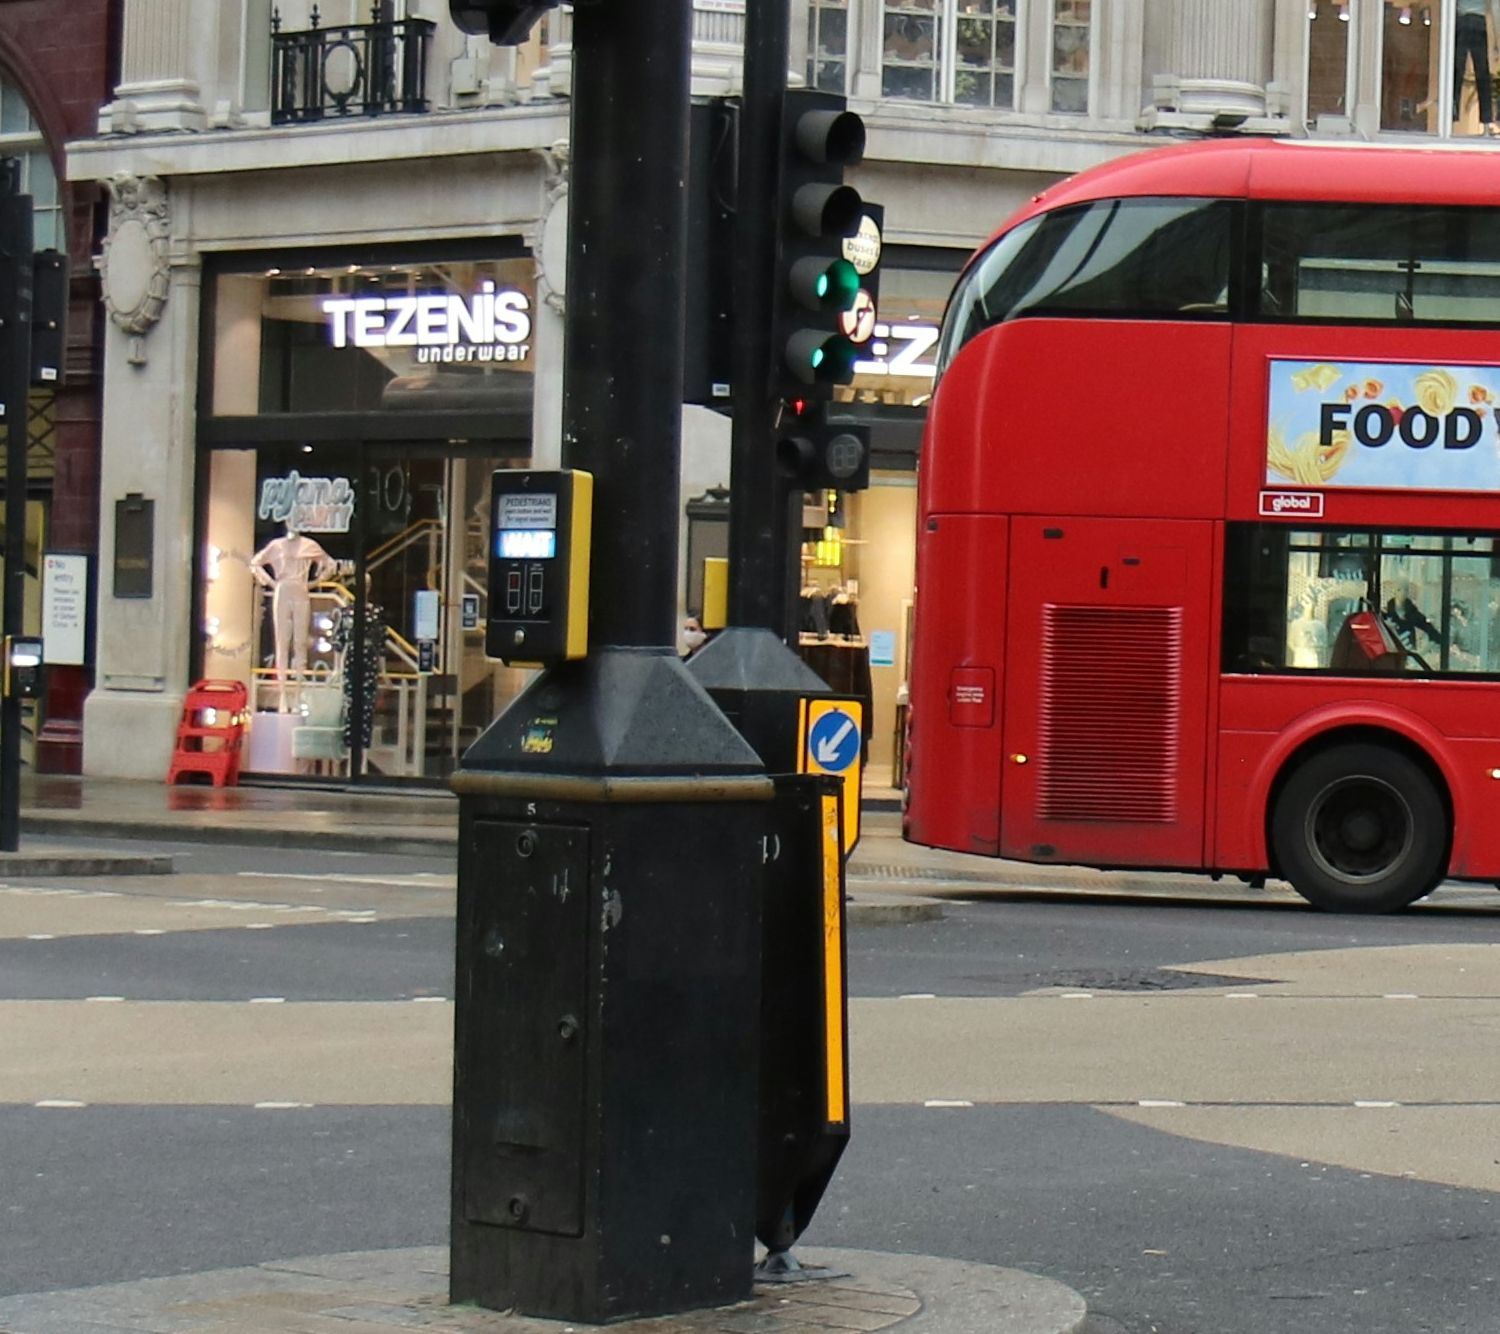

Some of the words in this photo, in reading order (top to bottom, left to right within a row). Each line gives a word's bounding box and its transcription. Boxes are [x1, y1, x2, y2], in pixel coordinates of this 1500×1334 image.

[418, 343, 530, 364] underwear
[1319, 403, 1484, 450] FOOD
[506, 498, 551, 508] PEDESTRIANS
[1272, 496, 1311, 512] global
[502, 531, 553, 557] WAIT
[527, 802, 536, 816] 5
